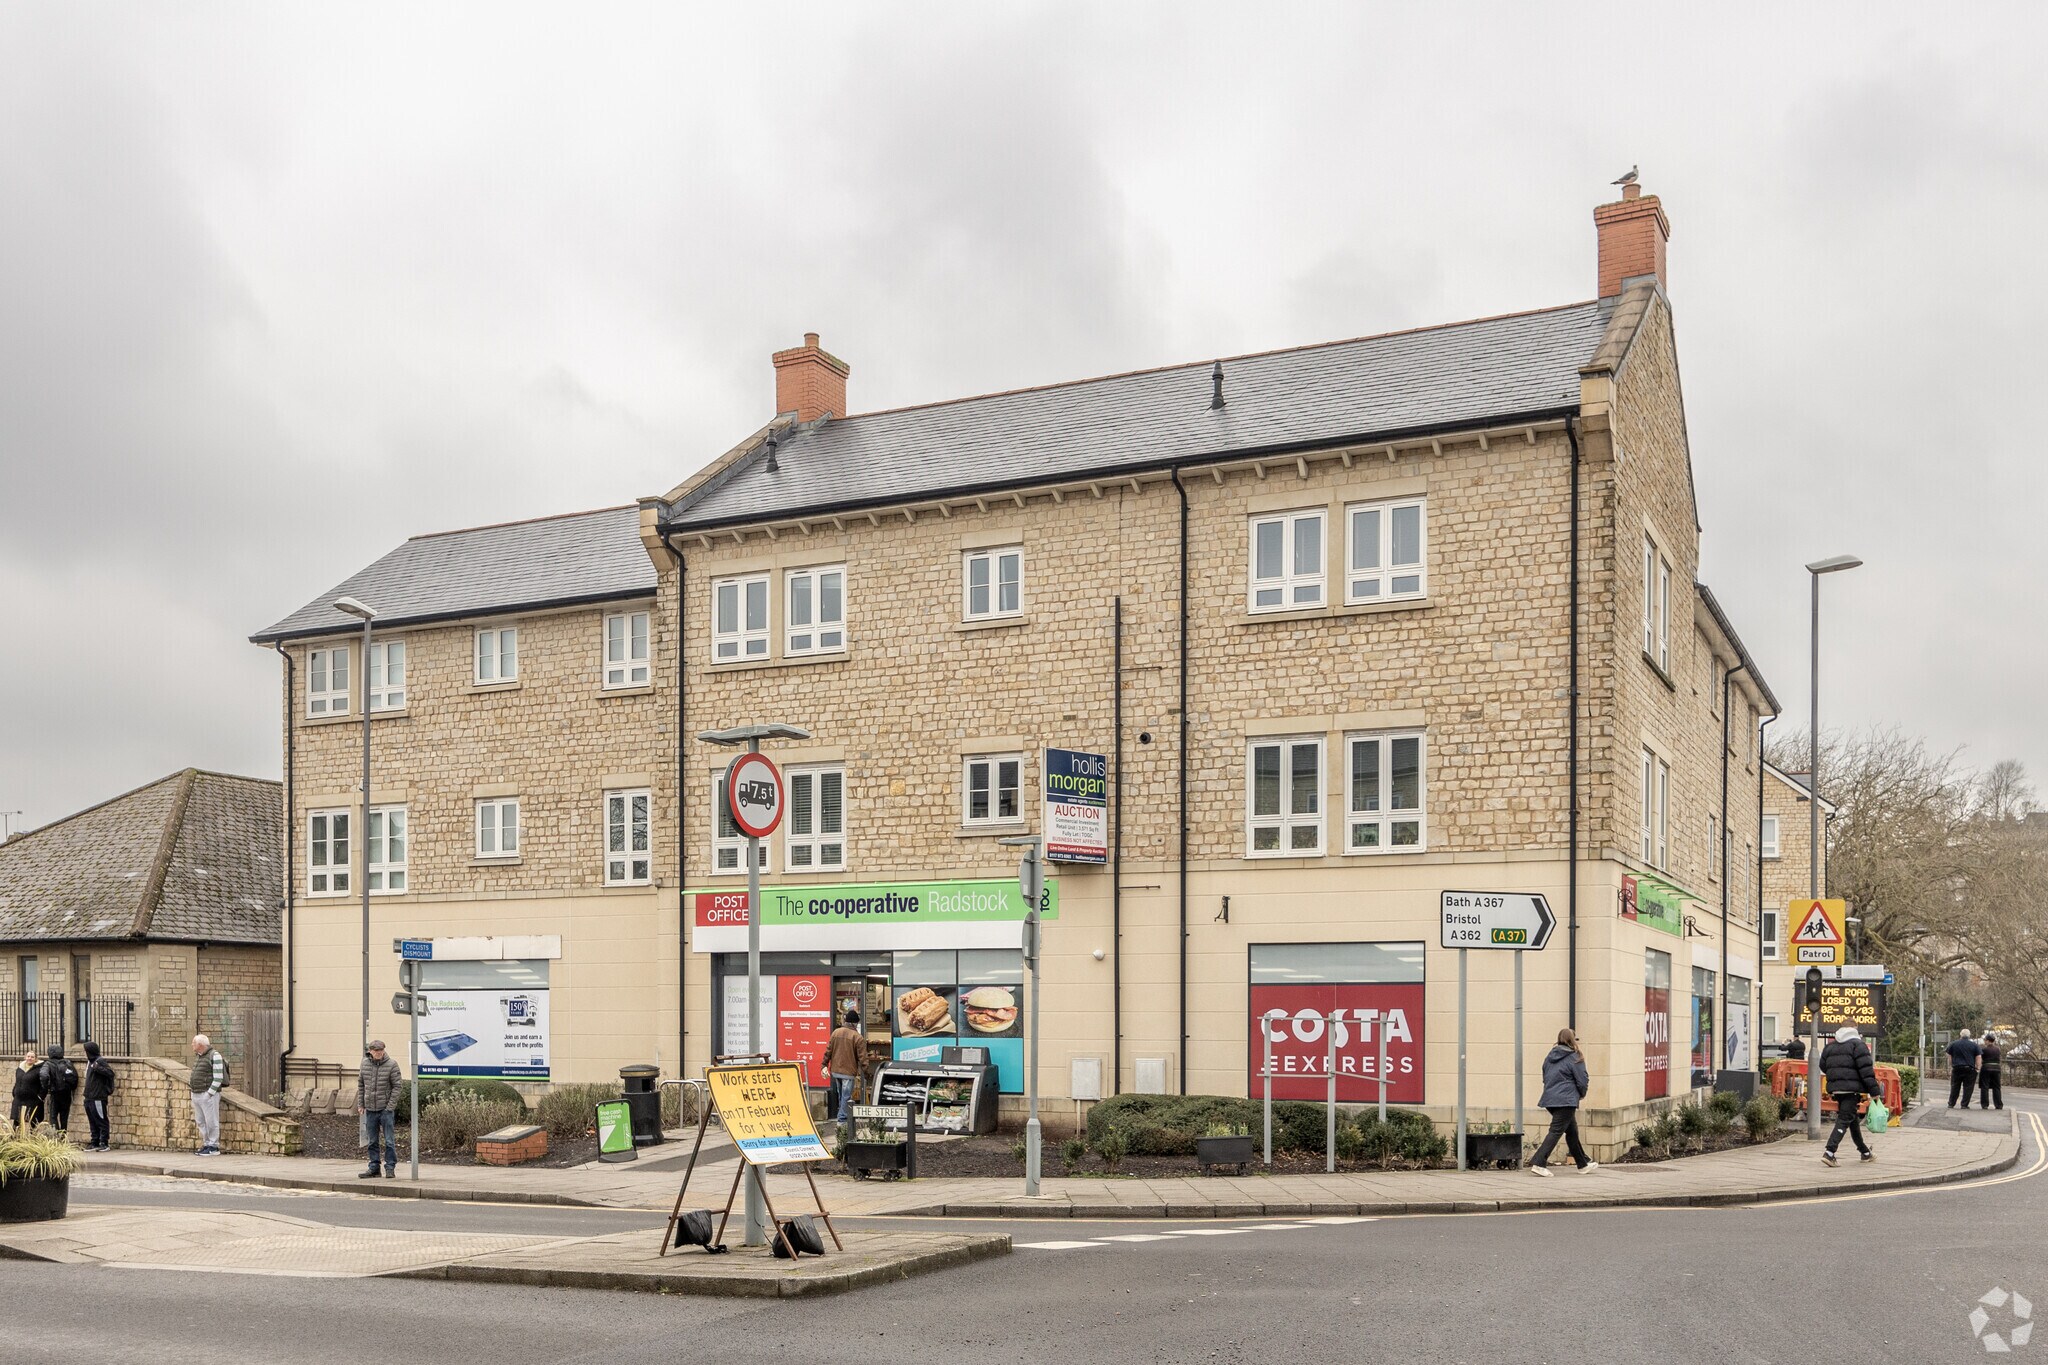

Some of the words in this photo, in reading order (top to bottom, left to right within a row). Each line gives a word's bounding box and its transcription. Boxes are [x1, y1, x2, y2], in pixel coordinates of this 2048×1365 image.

[1071, 754, 1105, 776] hollis
[1049, 773, 1105, 796] morgan
[1055, 804, 1099, 819] AUCTION
[714, 895, 745, 908] POST
[776, 896, 803, 916] The
[928, 890, 1009, 913] Radstock
[1446, 897, 1471, 907] Bath
[707, 909, 749, 922] OFFICE
[1446, 914, 1481, 925] Bristol
[404, 950, 431, 958] DISMOUNT
[1803, 950, 1830, 958] Patrol
[1821, 988, 1840, 996] OME
[1844, 988, 1869, 997] ROAD
[510, 1002, 522, 1011] 150
[1821, 997, 1851, 1006] LOSED
[1856, 998, 1869, 1006] ON
[1844, 1006, 1874, 1015] 07/03
[1261, 1008, 1413, 1049] COSTA
[1644, 1011, 1668, 1049] COSTA
[529, 1042, 544, 1050] profits
[902, 1050, 916, 1060] Hot
[917, 1047, 937, 1058] Food
[720, 1072, 748, 1086] Work
[752, 1071, 782, 1085] starts
[741, 1087, 772, 1102] HERE
[722, 1110, 734, 1120] on
[735, 1108, 745, 1118] 17
[748, 1104, 791, 1119] February
[856, 1106, 872, 1117] THE
[875, 1107, 905, 1117] STREET
[739, 1123, 755, 1134] for
[760, 1121, 765, 1132] 1
[767, 1119, 794, 1132] week
[741, 1141, 759, 1149] Sorry
[768, 1139, 779, 1147] any
